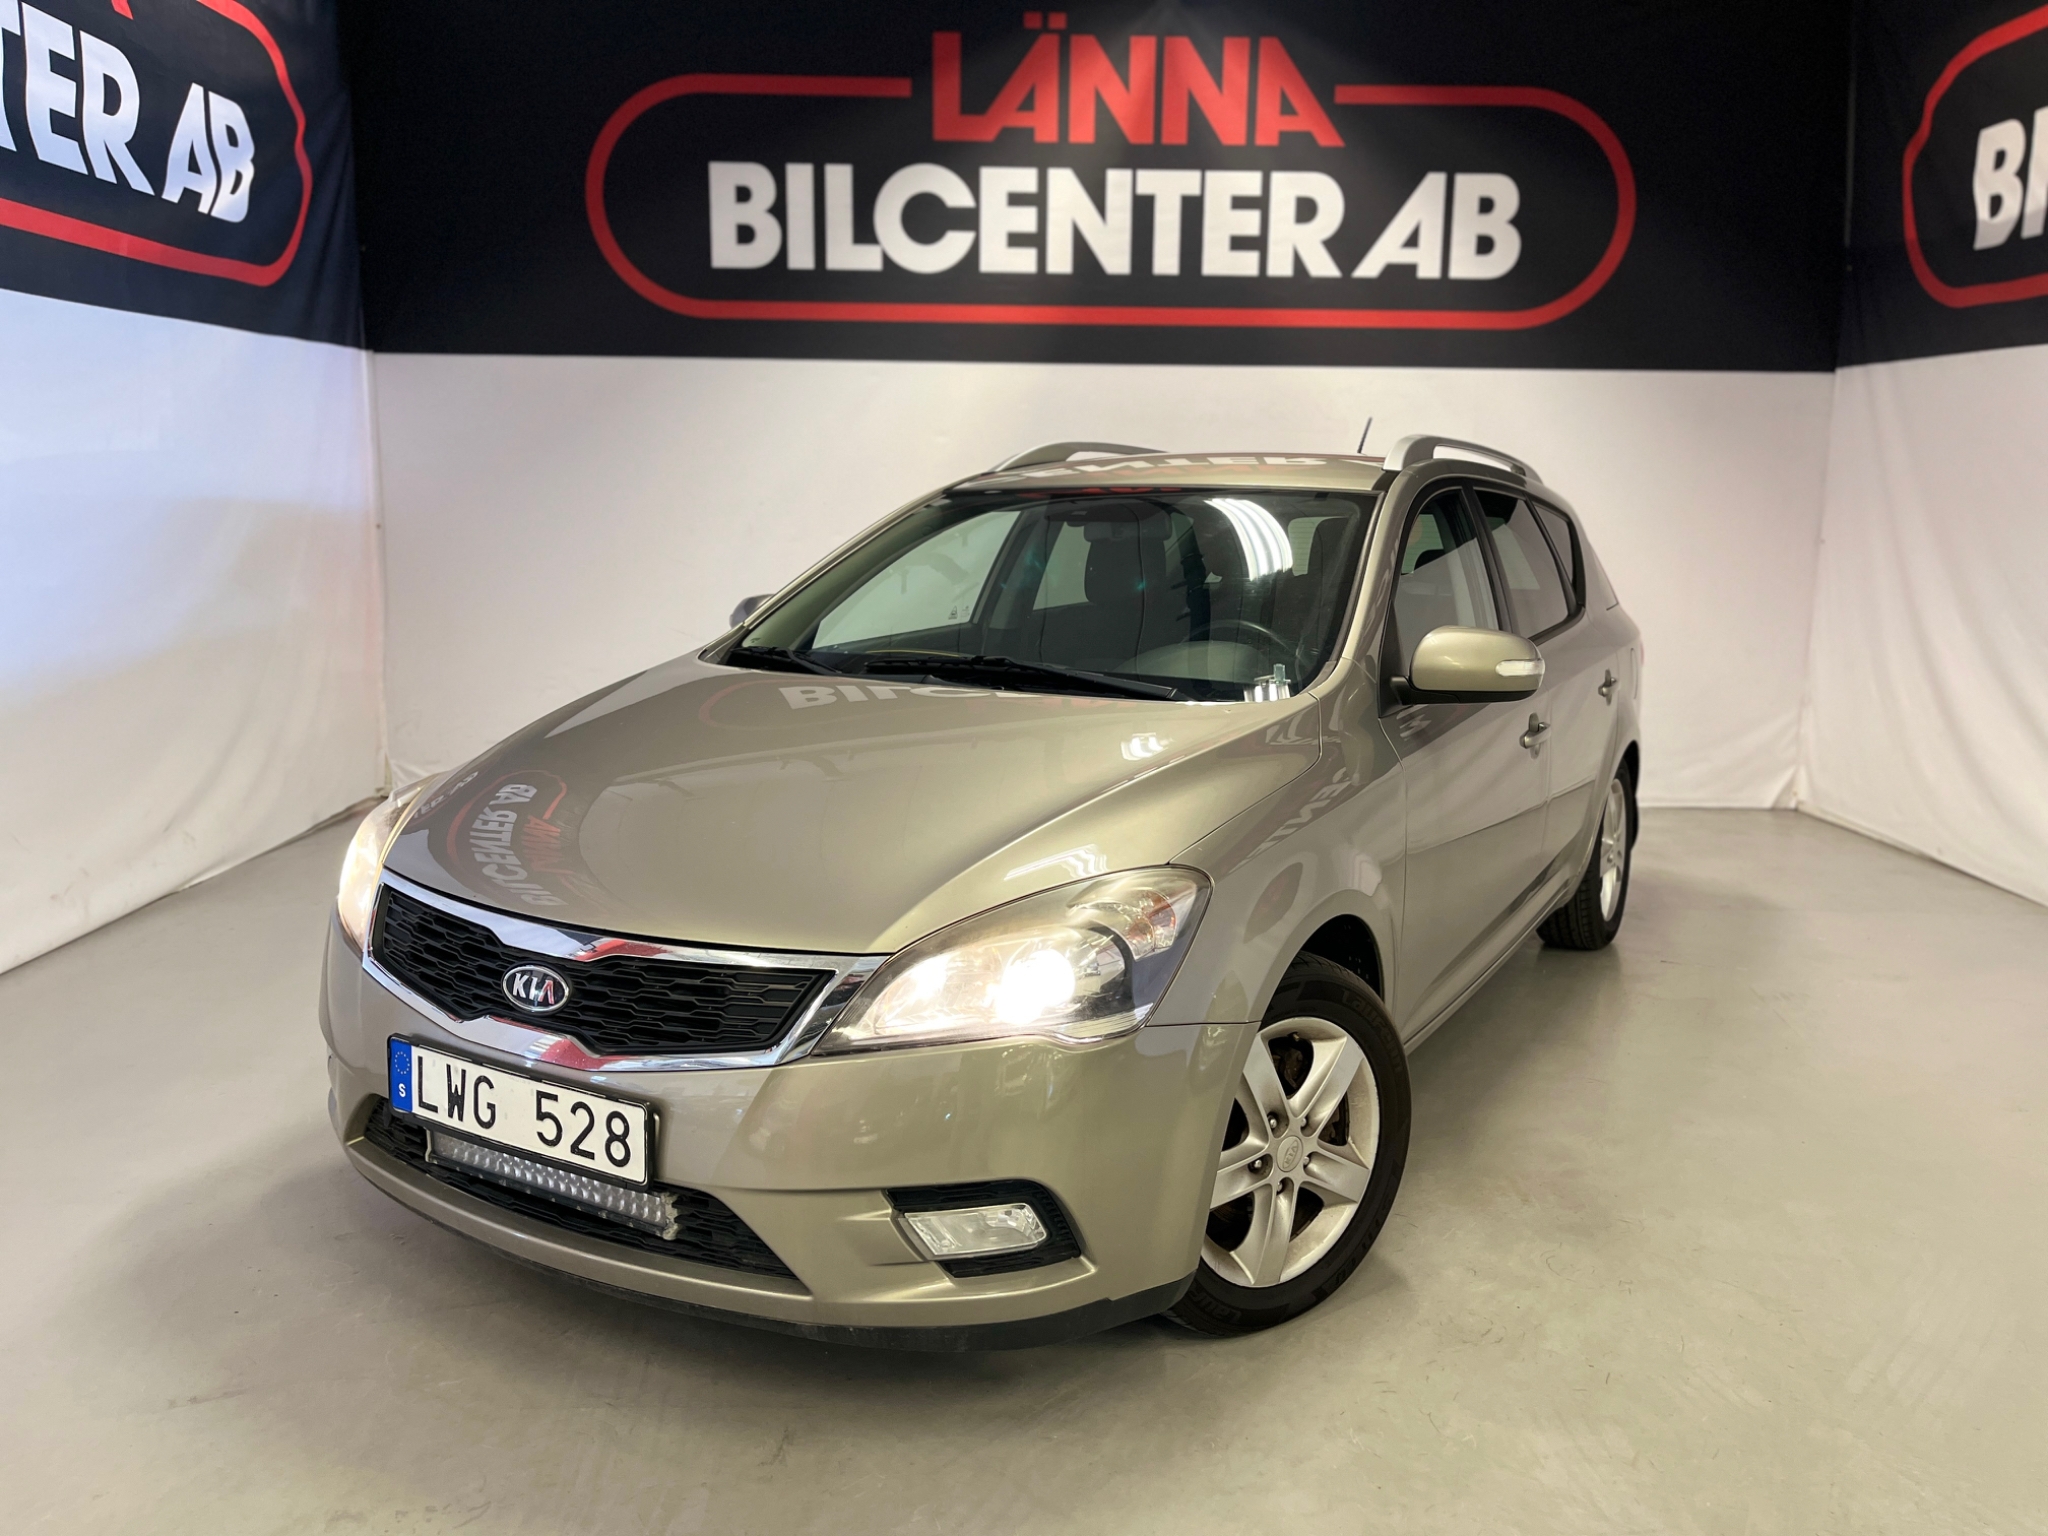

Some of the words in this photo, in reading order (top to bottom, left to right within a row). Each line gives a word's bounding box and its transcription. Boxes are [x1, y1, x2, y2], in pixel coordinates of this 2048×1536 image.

[931, 12, 1345, 147] LÄNNA
[161, 82, 255, 223] AB
[708, 160, 1345, 278] BILCENTER
[1351, 171, 1521, 280] AB
[513, 973, 555, 1005] KIA
[398, 1083, 407, 1098] S
[417, 1056, 496, 1129] LWG
[536, 1090, 631, 1168] 528
